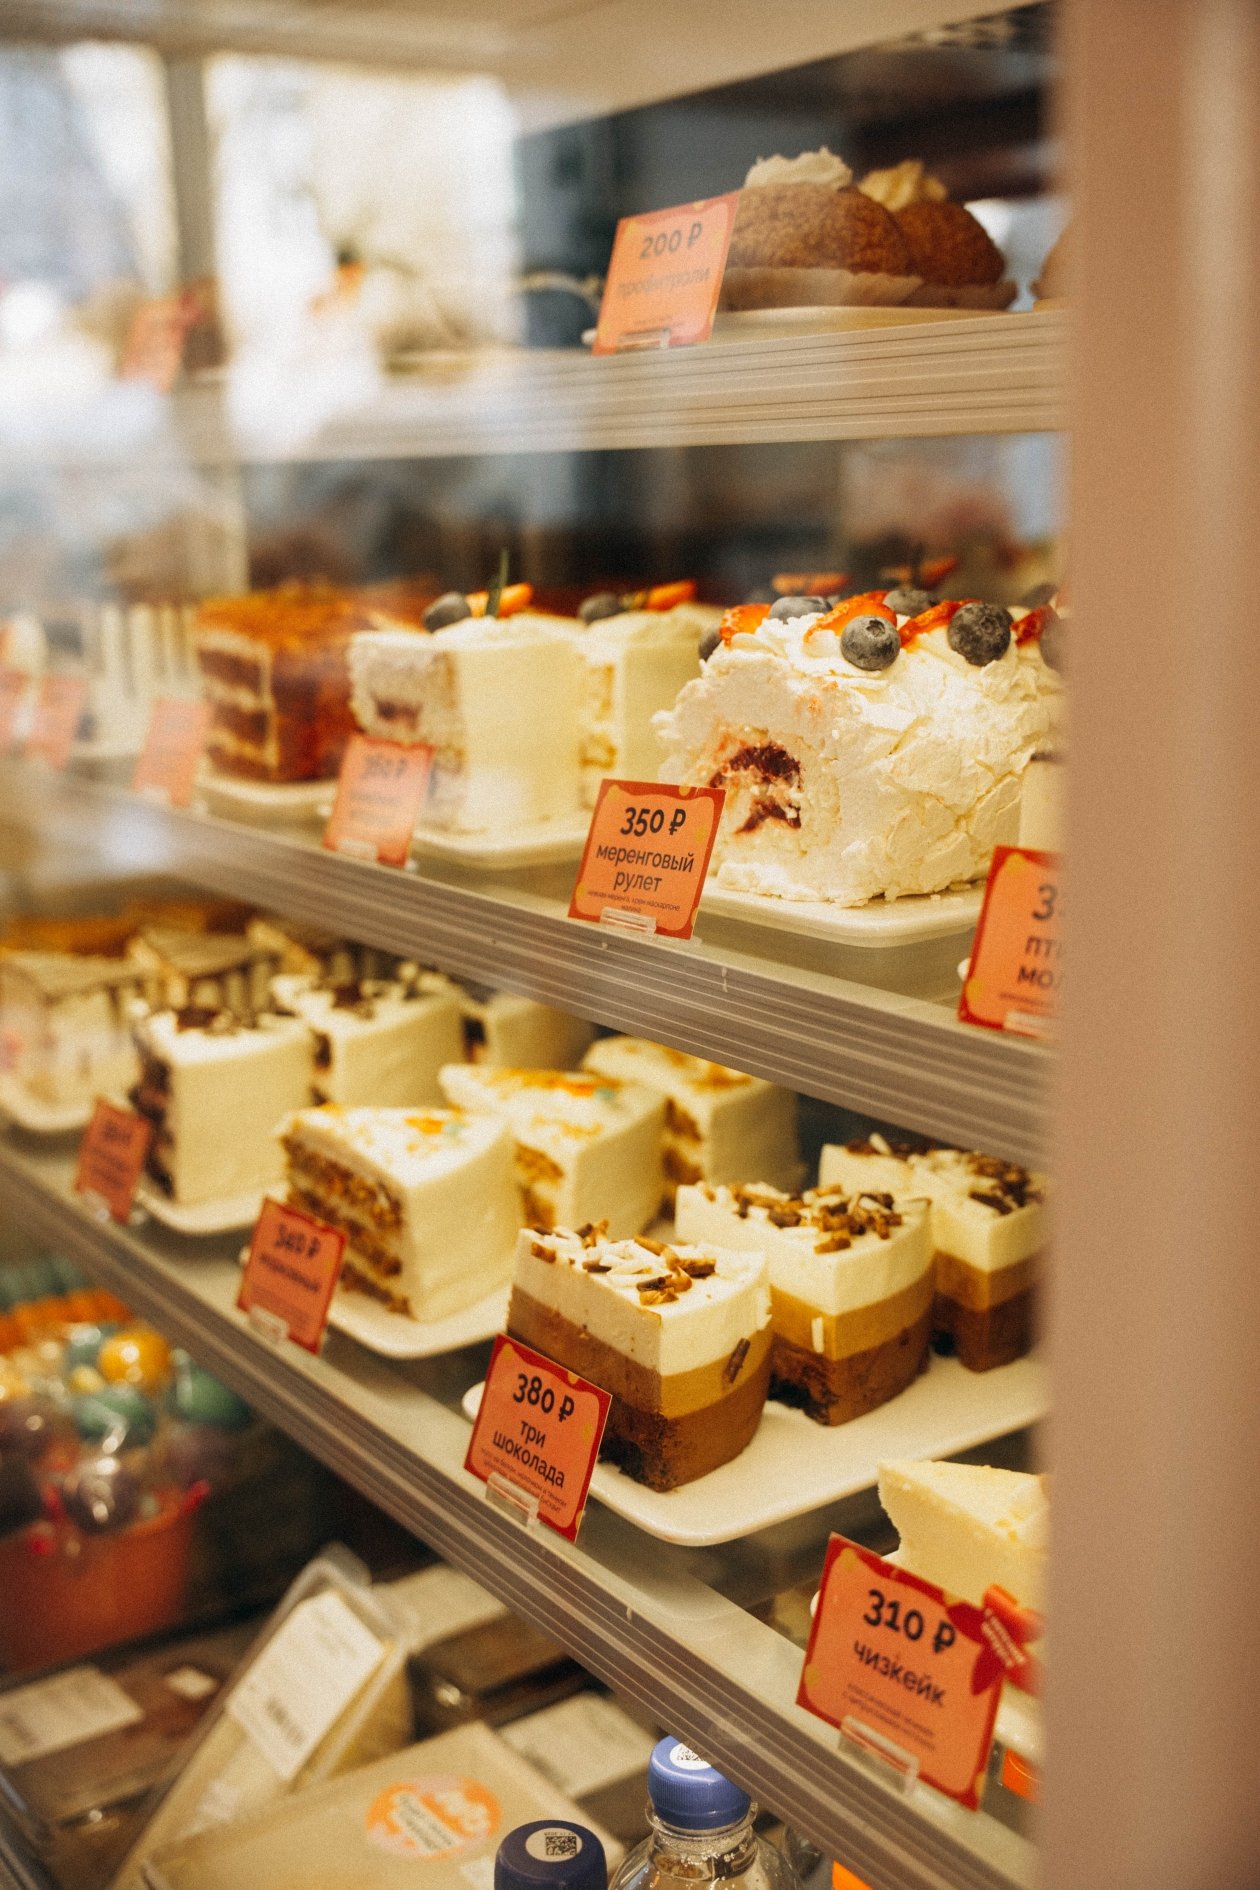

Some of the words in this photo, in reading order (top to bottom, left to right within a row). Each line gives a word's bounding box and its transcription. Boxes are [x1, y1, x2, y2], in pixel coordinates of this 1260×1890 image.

[639, 229, 682, 260] 200
[620, 806, 665, 837] 350
[668, 808, 687, 836] ₽
[595, 844, 695, 873] меренговый
[613, 871, 662, 893] рулет
[1024, 935, 1063, 960] пт
[1017, 965, 1064, 989] мо
[513, 1372, 555, 1415] 380
[557, 1394, 575, 1423] ₽
[519, 1420, 546, 1448] три
[492, 1430, 565, 1489] шоколада
[863, 1588, 924, 1641] 310
[931, 1620, 957, 1655] ₽
[854, 1639, 947, 1708] чизкейк
